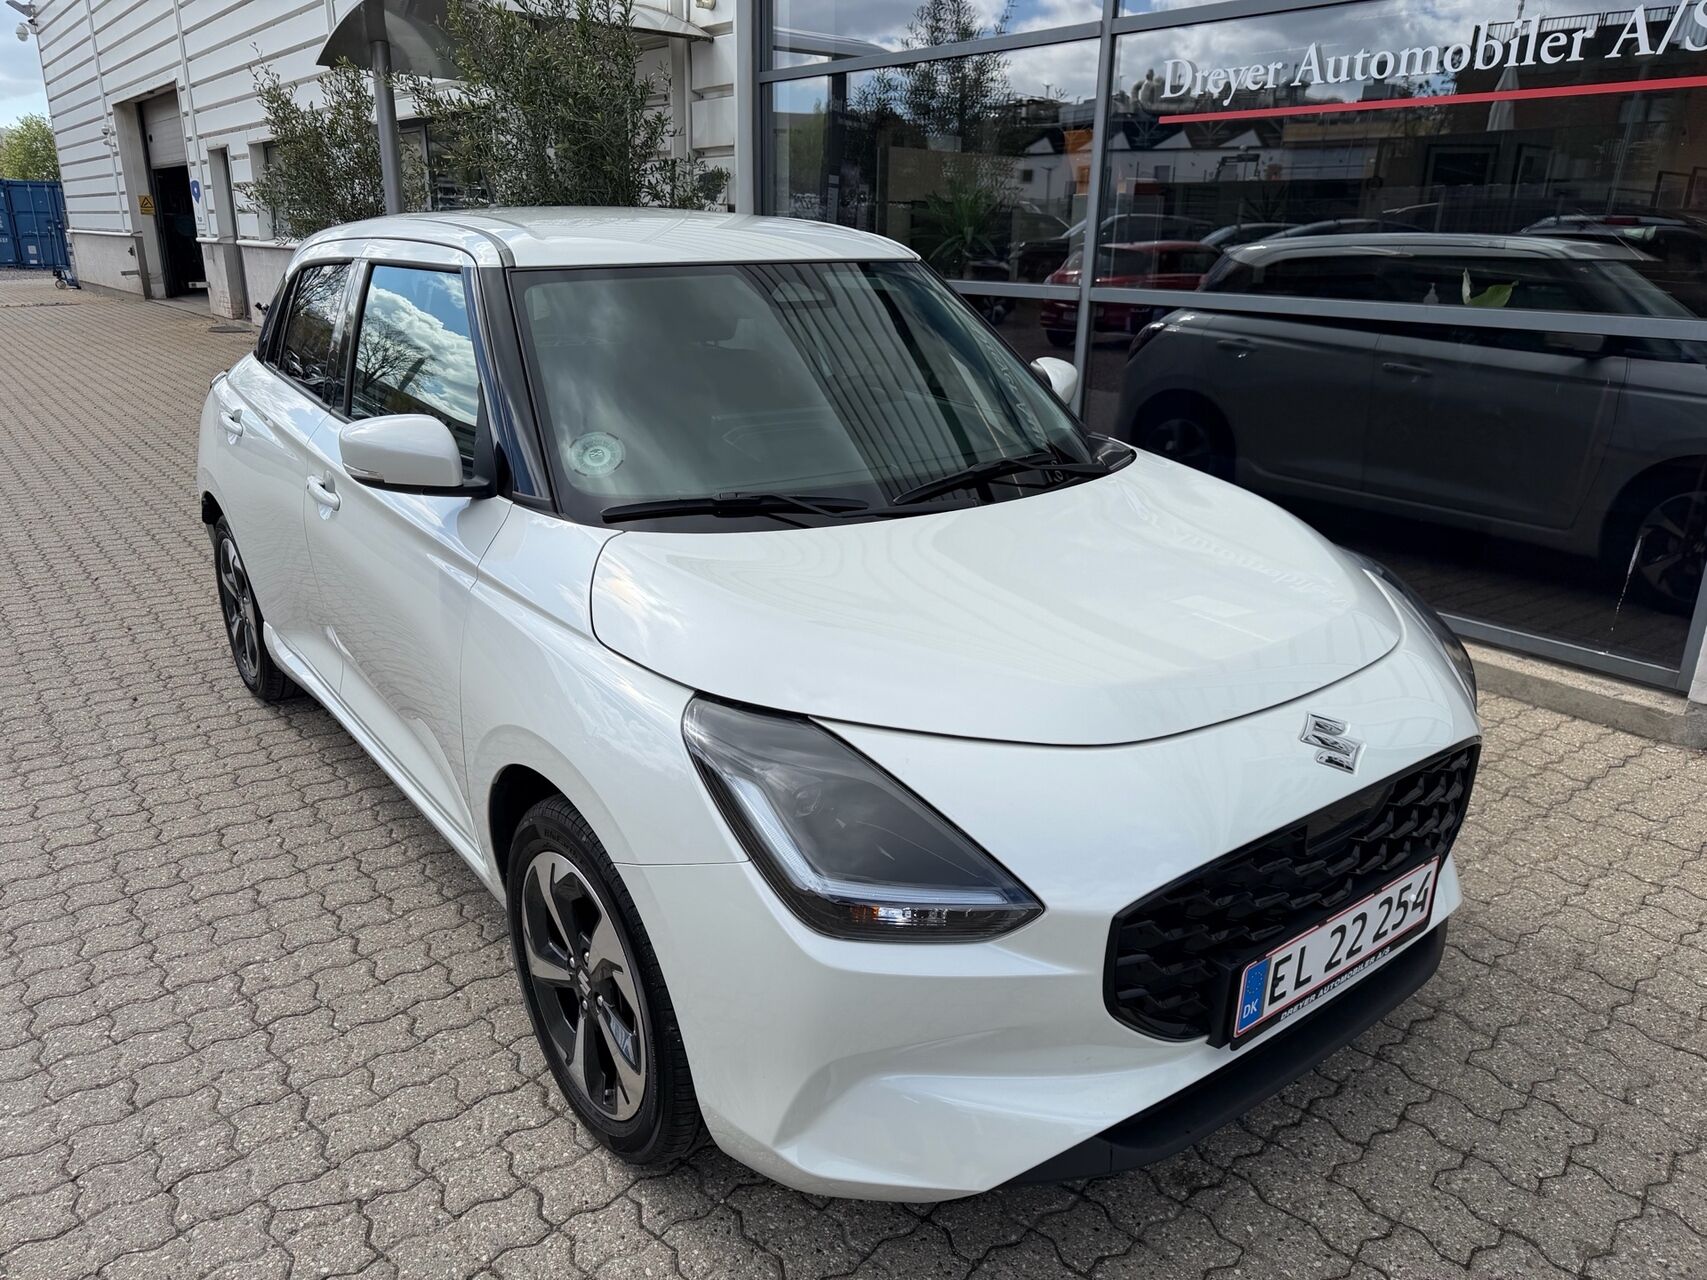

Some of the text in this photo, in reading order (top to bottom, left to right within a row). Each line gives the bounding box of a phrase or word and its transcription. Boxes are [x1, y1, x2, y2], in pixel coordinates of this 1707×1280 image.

[1160, 59, 1283, 107] Dreyer
[1290, 13, 1595, 86] Automobiler
[1268, 870, 1432, 1006] EL 22 254
[1242, 998, 1259, 1019] DK
[1280, 993, 1316, 1021] DREYER
[1317, 955, 1377, 999] AUTOMOBILER
